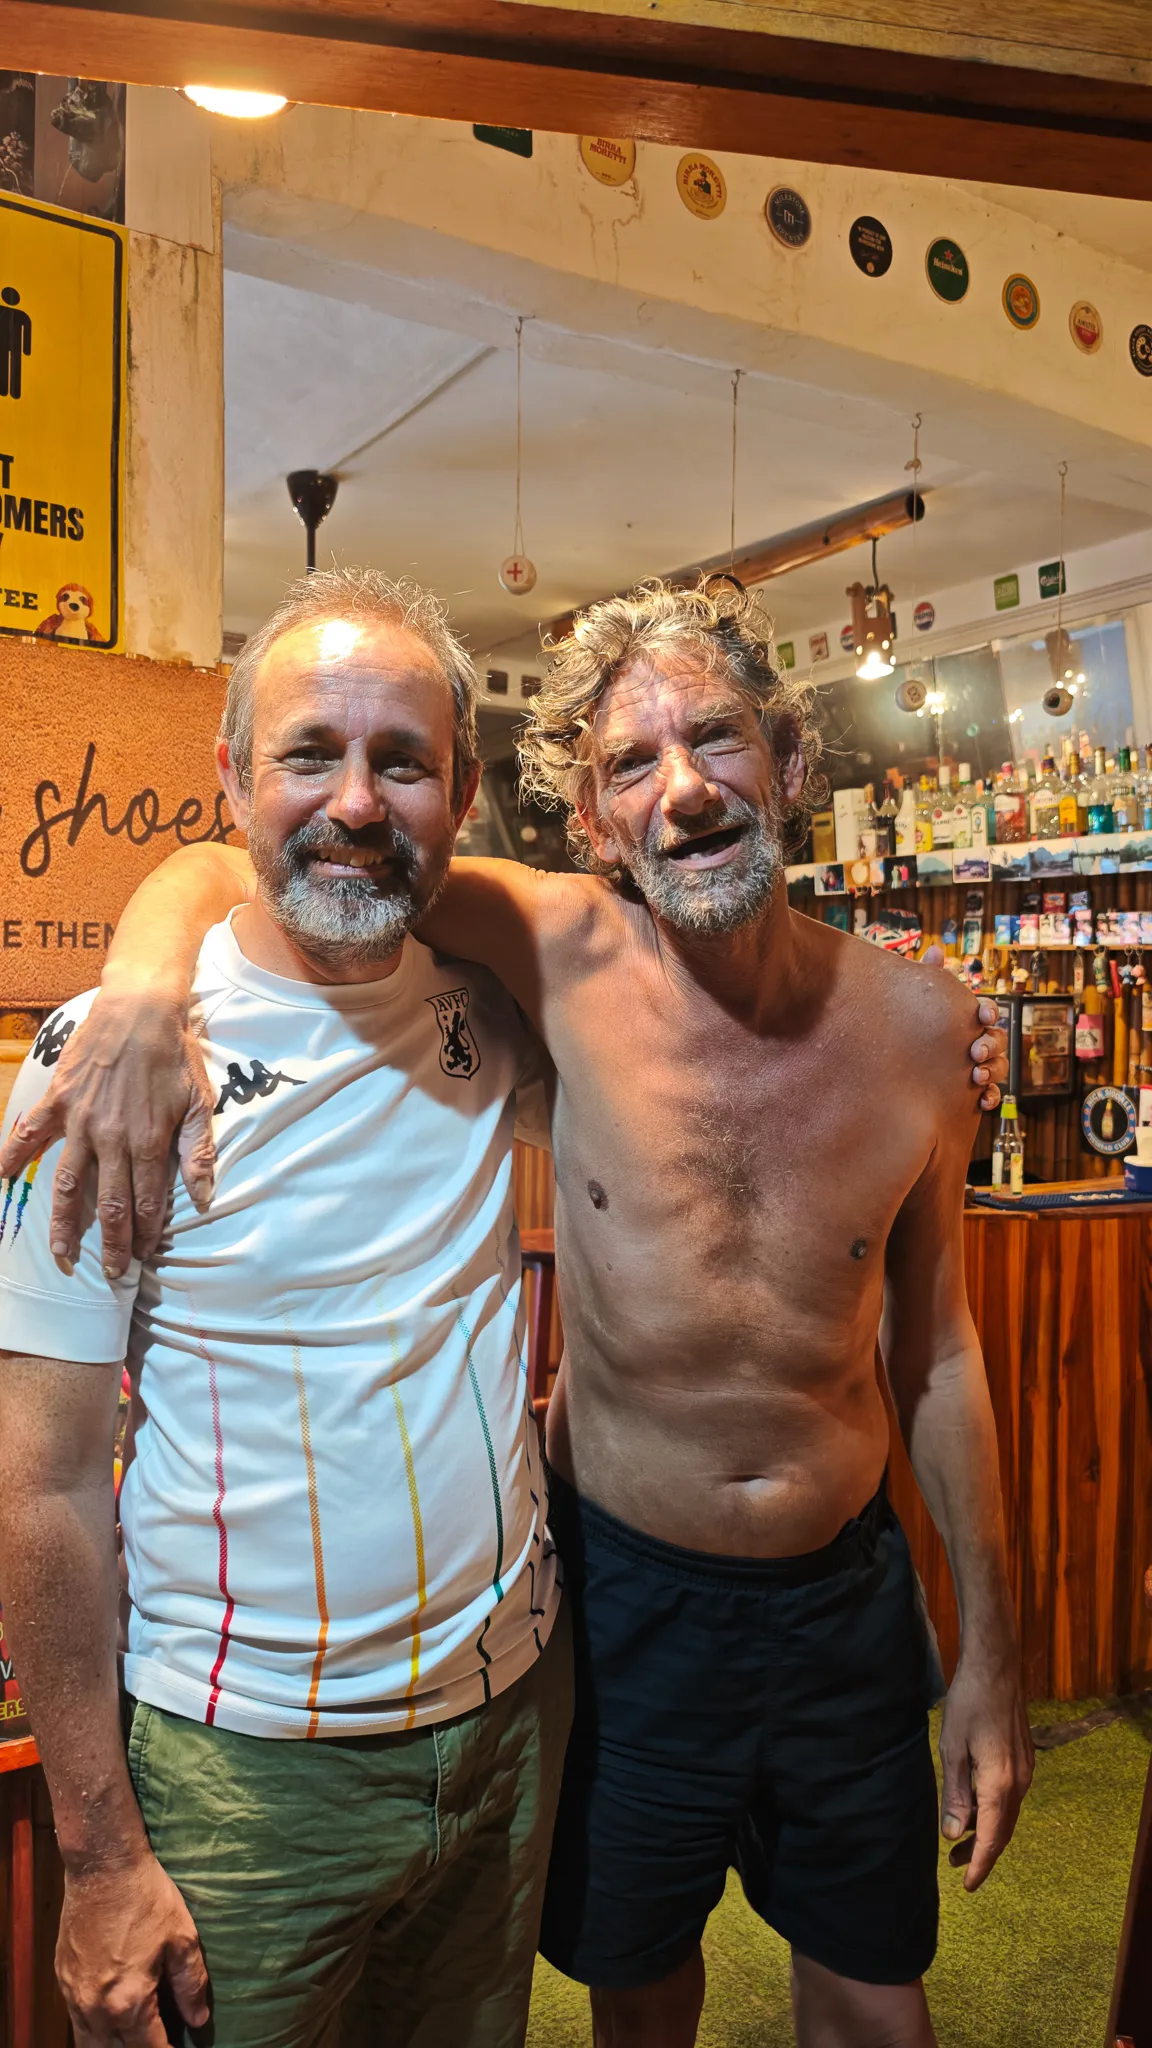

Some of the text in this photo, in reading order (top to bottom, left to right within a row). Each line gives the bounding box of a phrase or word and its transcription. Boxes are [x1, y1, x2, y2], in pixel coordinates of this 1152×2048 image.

[590, 143, 626, 165] MORETTI
[597, 138, 622, 155] BIRRA
[683, 163, 722, 198] BIRRA MORETTI
[933, 257, 963, 276] Heineken
[0, 494, 84, 541] MERS
[0, 588, 38, 610] EE
[437, 992, 467, 1012] AVFC
